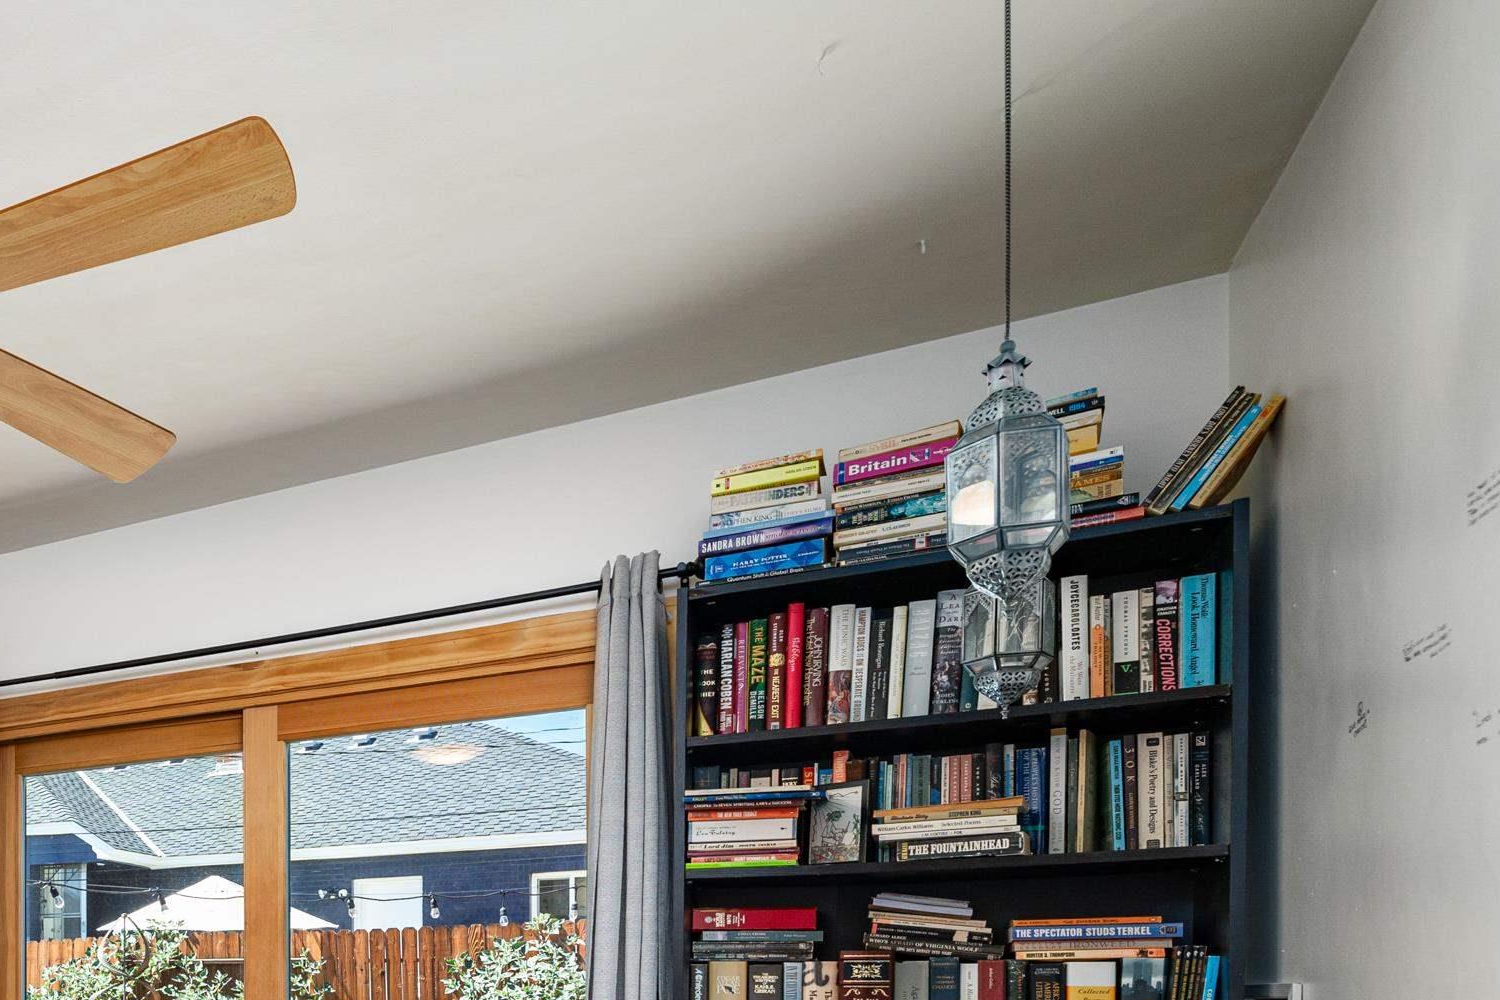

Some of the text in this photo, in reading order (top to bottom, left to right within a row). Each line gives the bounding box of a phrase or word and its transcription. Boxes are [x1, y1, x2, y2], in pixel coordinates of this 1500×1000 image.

[1069, 401, 1086, 412] 1984
[848, 455, 907, 477] Britain
[702, 540, 733, 554] SANDRA
[735, 532, 765, 547] BROWN
[732, 558, 759, 568] HARRY
[761, 553, 788, 562] POTTER
[1200, 577, 1208, 601] Thomas
[878, 621, 886, 642] Richard
[1189, 592, 1200, 675] Look Angel
[751, 627, 764, 684] THE MAZE
[812, 635, 823, 687] JOHN IRVING
[875, 643, 885, 669] Brautigan
[1156, 619, 1176, 691] CORRECTIONS
[720, 640, 733, 709] HARLAN COBEN
[1120, 664, 1133, 673] V.
[757, 690, 765, 719] NELSON
[771, 705, 779, 718] EXIT
[1053, 790, 1063, 815] GOD
[1148, 750, 1157, 834] Blake's Poetry and Designs
[908, 838, 1010, 856] THE FOUNTAINHEAD
[1015, 926, 1152, 938] THE SPECTATOR STUDS TERKEL
[925, 943, 955, 951] VIRGINIA
[956, 945, 980, 953] WOOLF
[1069, 940, 1136, 949] IRONWEED
